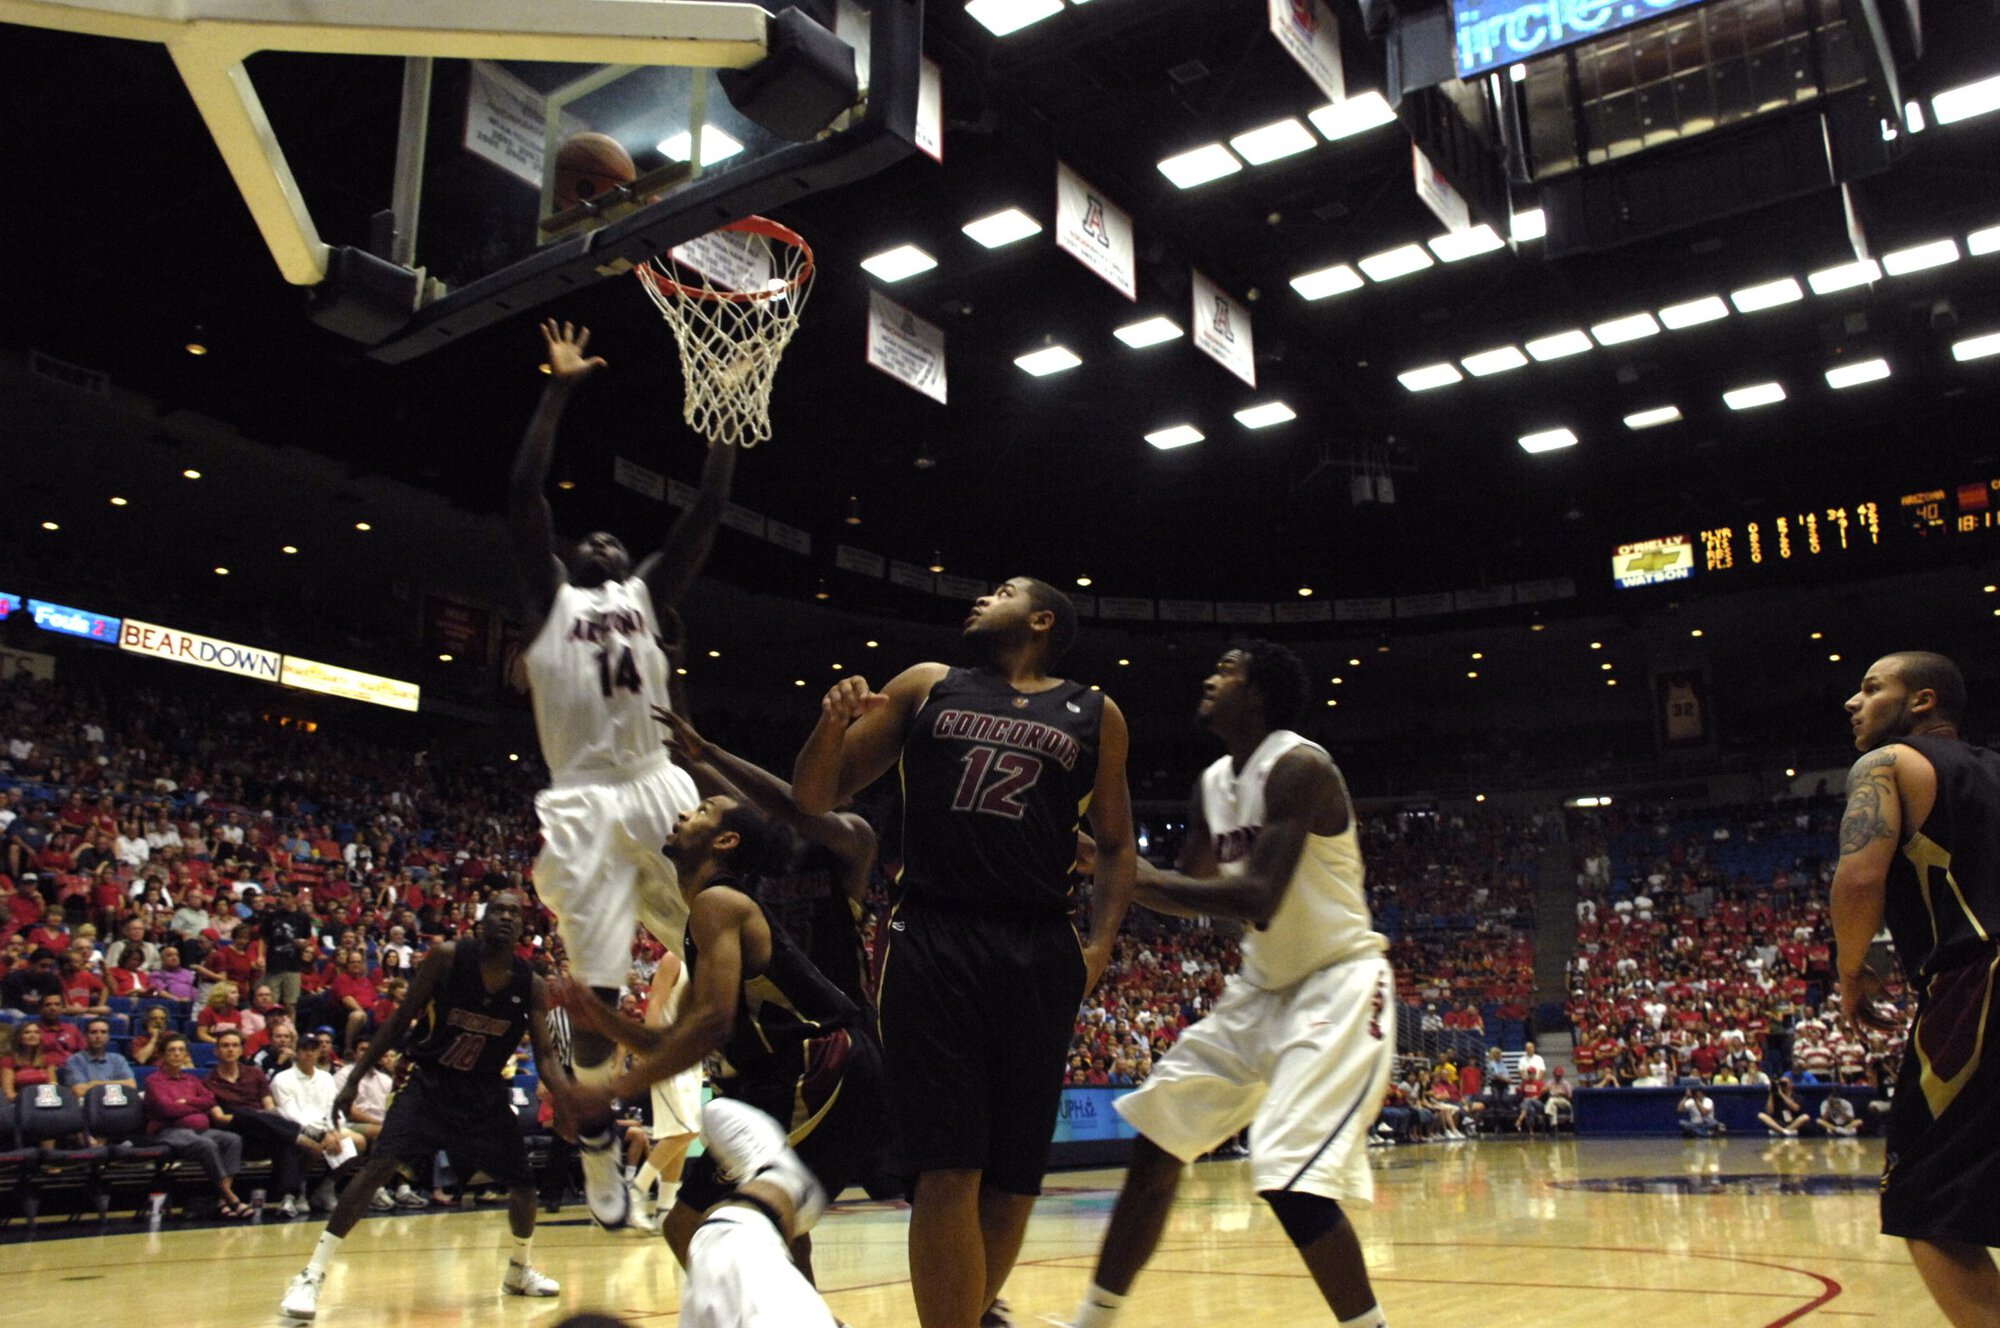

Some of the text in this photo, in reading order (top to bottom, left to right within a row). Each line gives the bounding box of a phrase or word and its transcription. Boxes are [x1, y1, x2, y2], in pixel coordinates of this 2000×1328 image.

[1618, 534, 1684, 555] O'RIELLY
[1621, 568, 1688, 588] WATSON
[34, 605, 105, 636] Fouls 2
[594, 645, 642, 698] 14
[932, 708, 1081, 771] CONCORDIA
[951, 745, 1044, 821] 12
